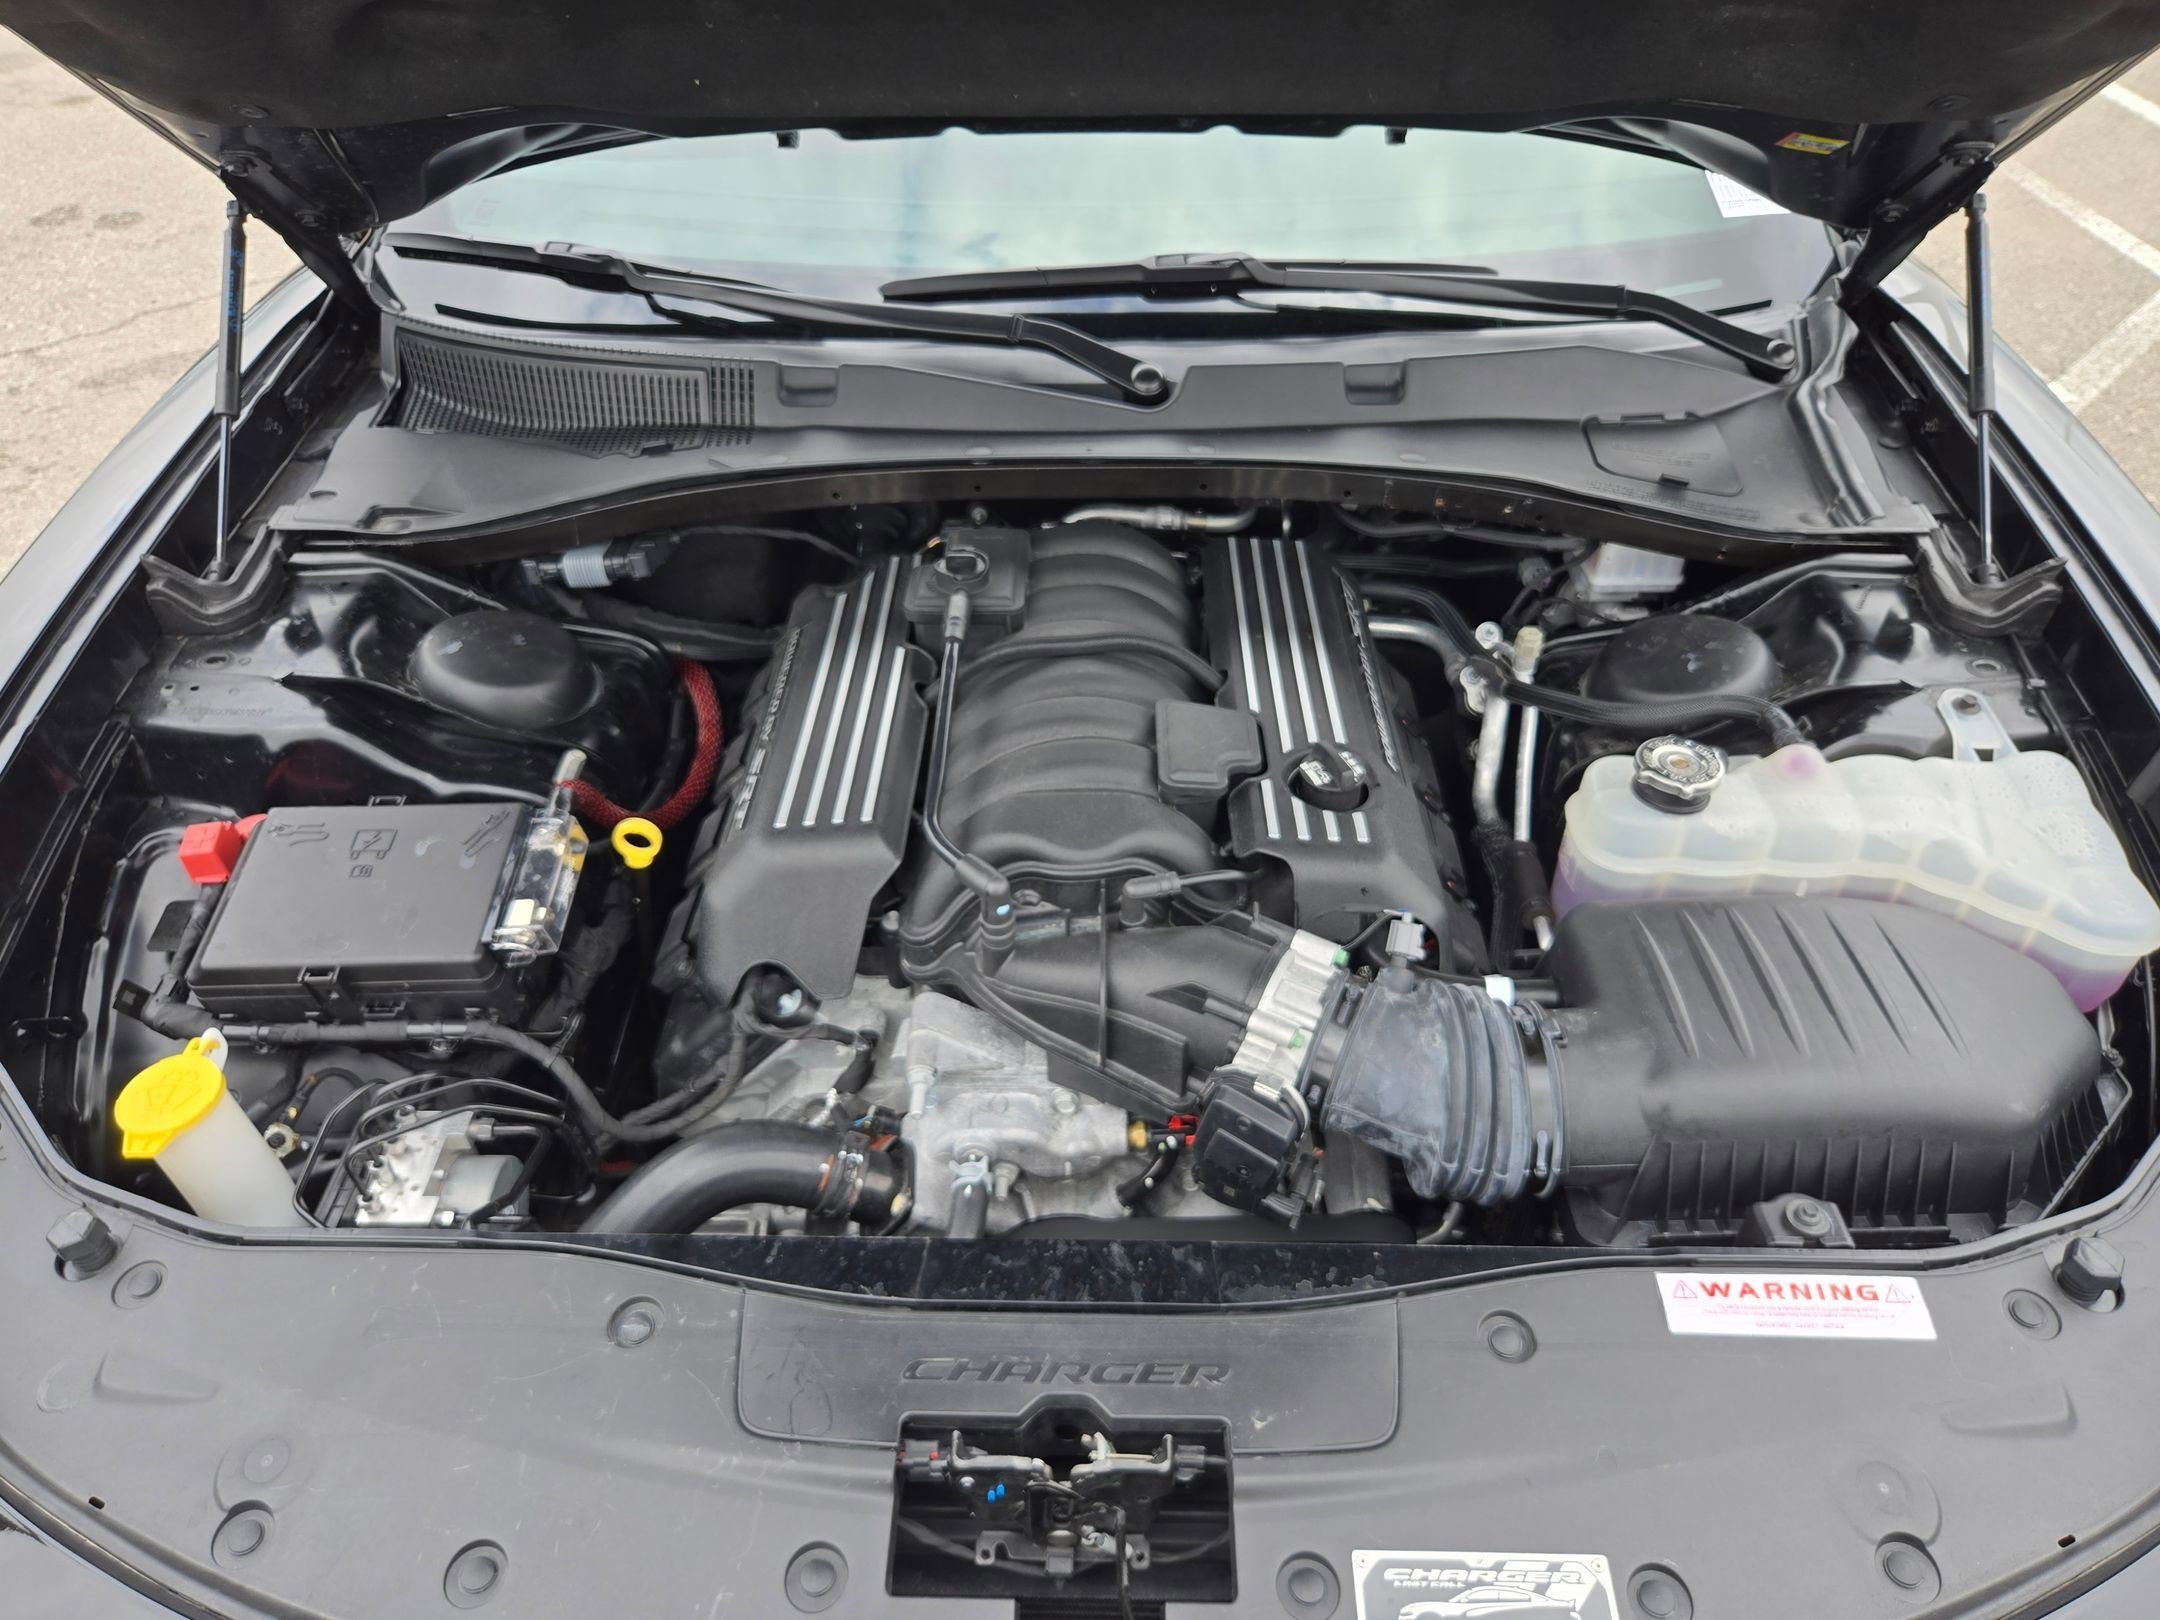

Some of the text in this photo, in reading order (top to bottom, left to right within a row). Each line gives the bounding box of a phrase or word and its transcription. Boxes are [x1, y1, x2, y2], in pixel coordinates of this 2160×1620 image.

[732, 748, 767, 830] SRT
[1698, 1281, 1880, 1301] WARNING
[902, 1357, 1233, 1386] CHARGER
[1383, 1567, 1586, 1585] CHARGER
